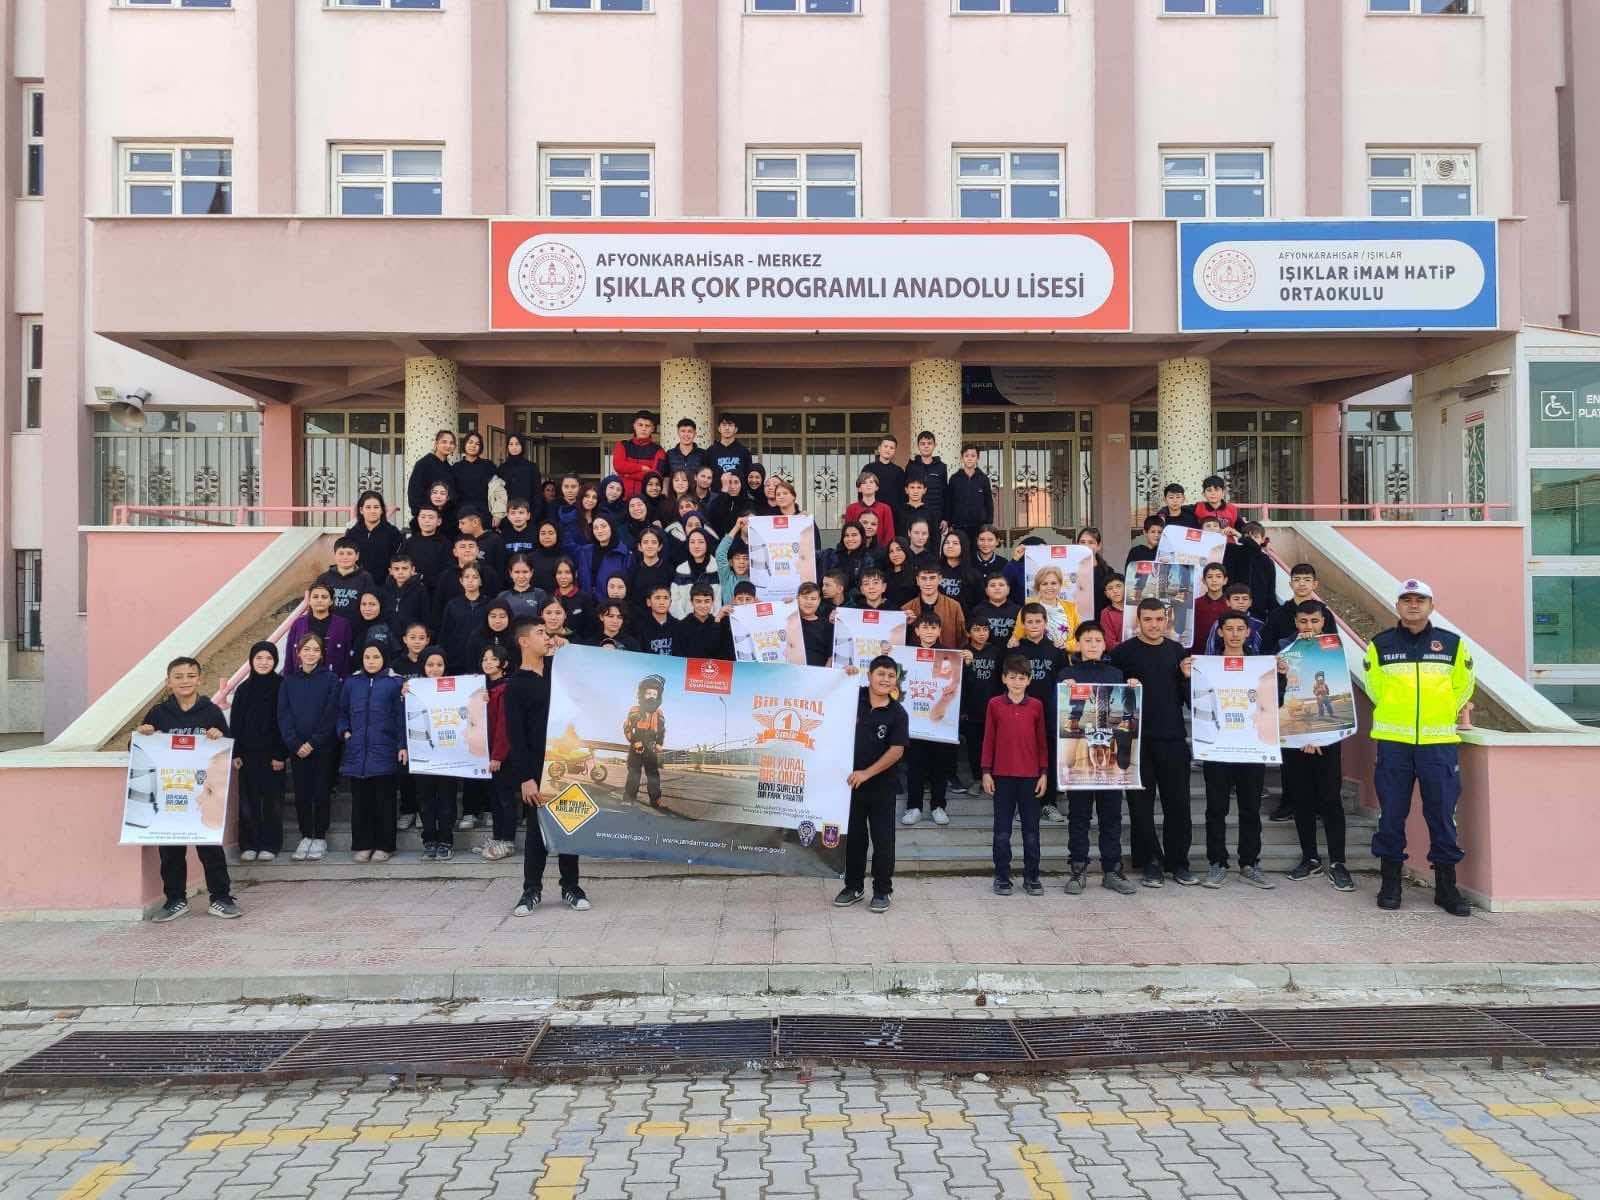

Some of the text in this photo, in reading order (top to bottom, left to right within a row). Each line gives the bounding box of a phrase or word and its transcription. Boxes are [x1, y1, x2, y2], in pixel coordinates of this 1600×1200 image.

[596, 251, 744, 267] AFYONKARAHİSAR
[758, 253, 822, 267] MERKEZ
[1280, 265, 1349, 283] IŞIKLAR
[595, 276, 686, 303] IŞIKLAR
[691, 276, 741, 304] ÇOK
[746, 276, 887, 298] PROGRAMLI
[893, 277, 1010, 298] ANADOLU
[1016, 272, 1085, 299] LİSESİ
[1280, 286, 1384, 301] ORTAOKULU
